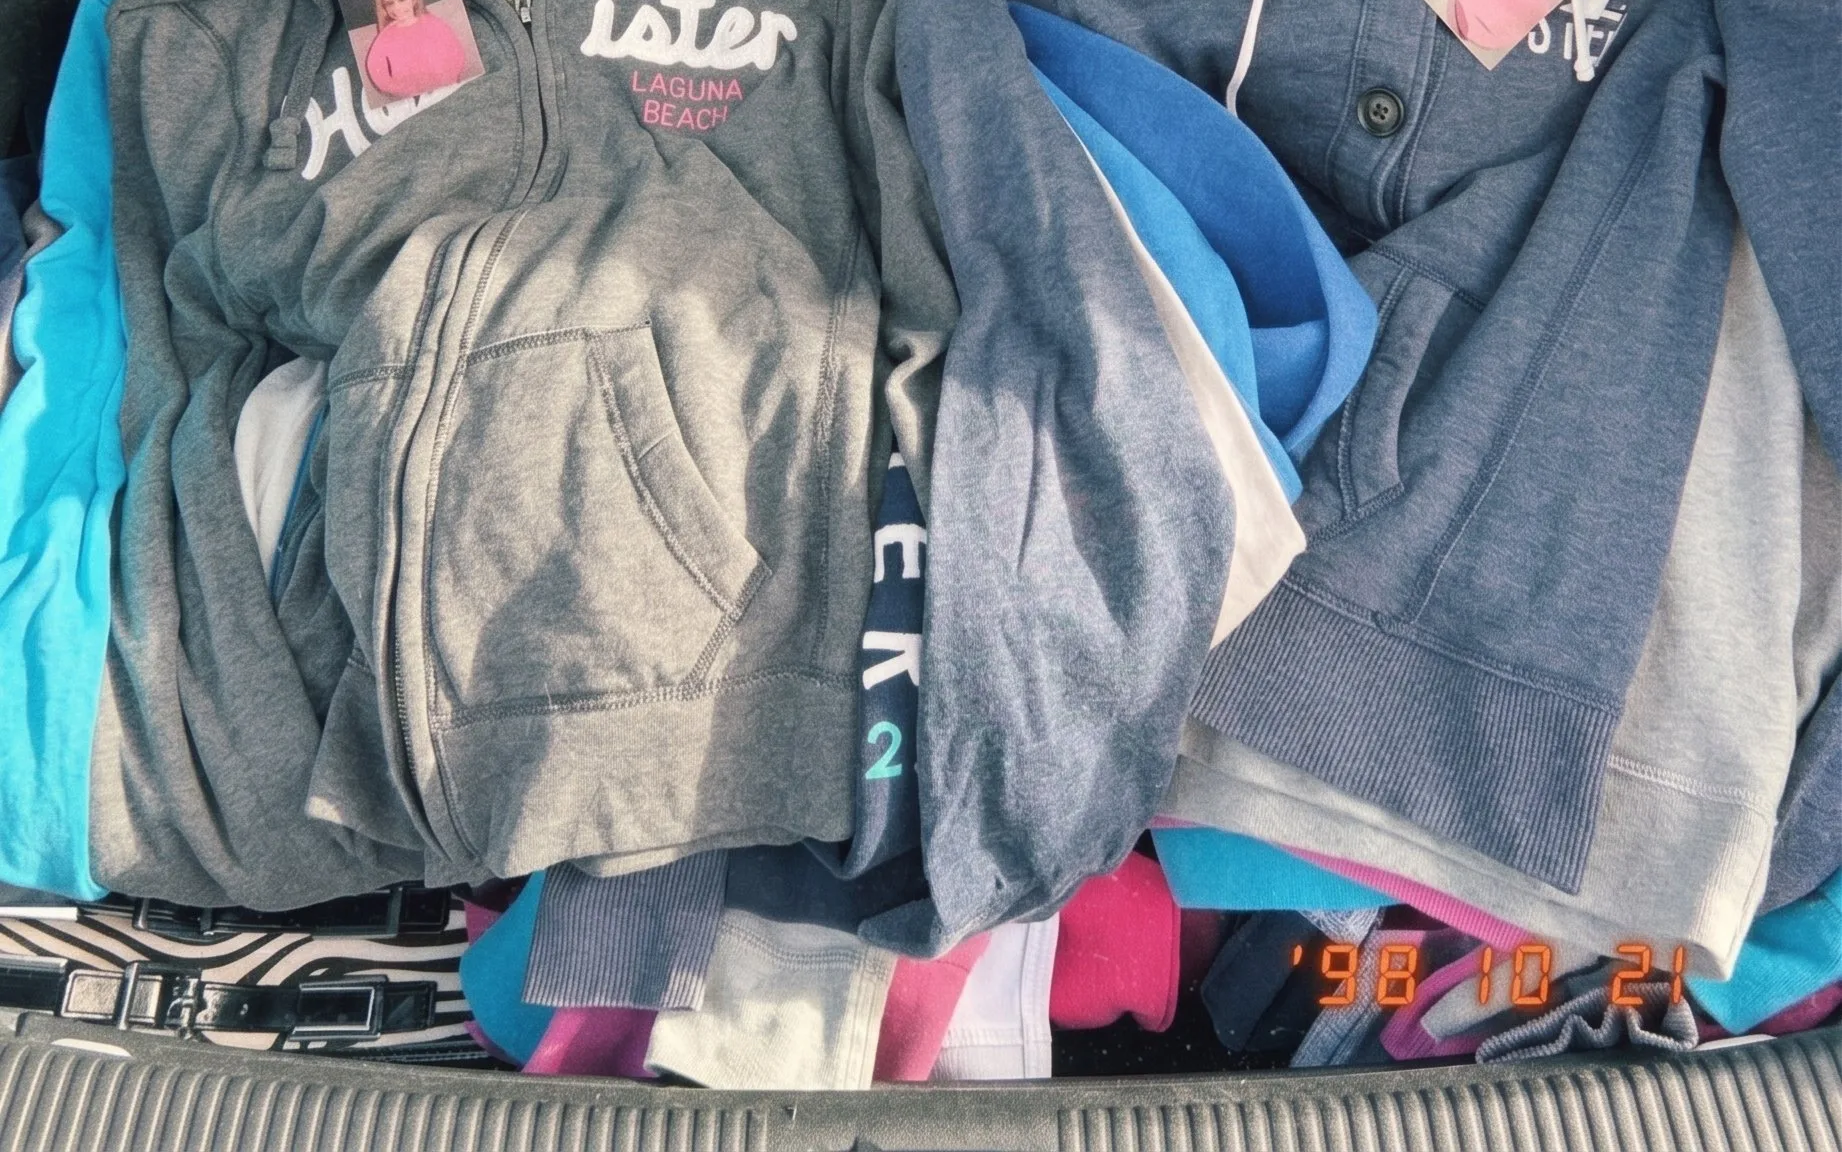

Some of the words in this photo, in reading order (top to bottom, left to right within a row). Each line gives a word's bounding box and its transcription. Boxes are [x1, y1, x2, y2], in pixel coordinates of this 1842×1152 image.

[631, 71, 743, 101] LAGUNA
[643, 100, 728, 130] BEACH
[865, 721, 903, 780] 2
